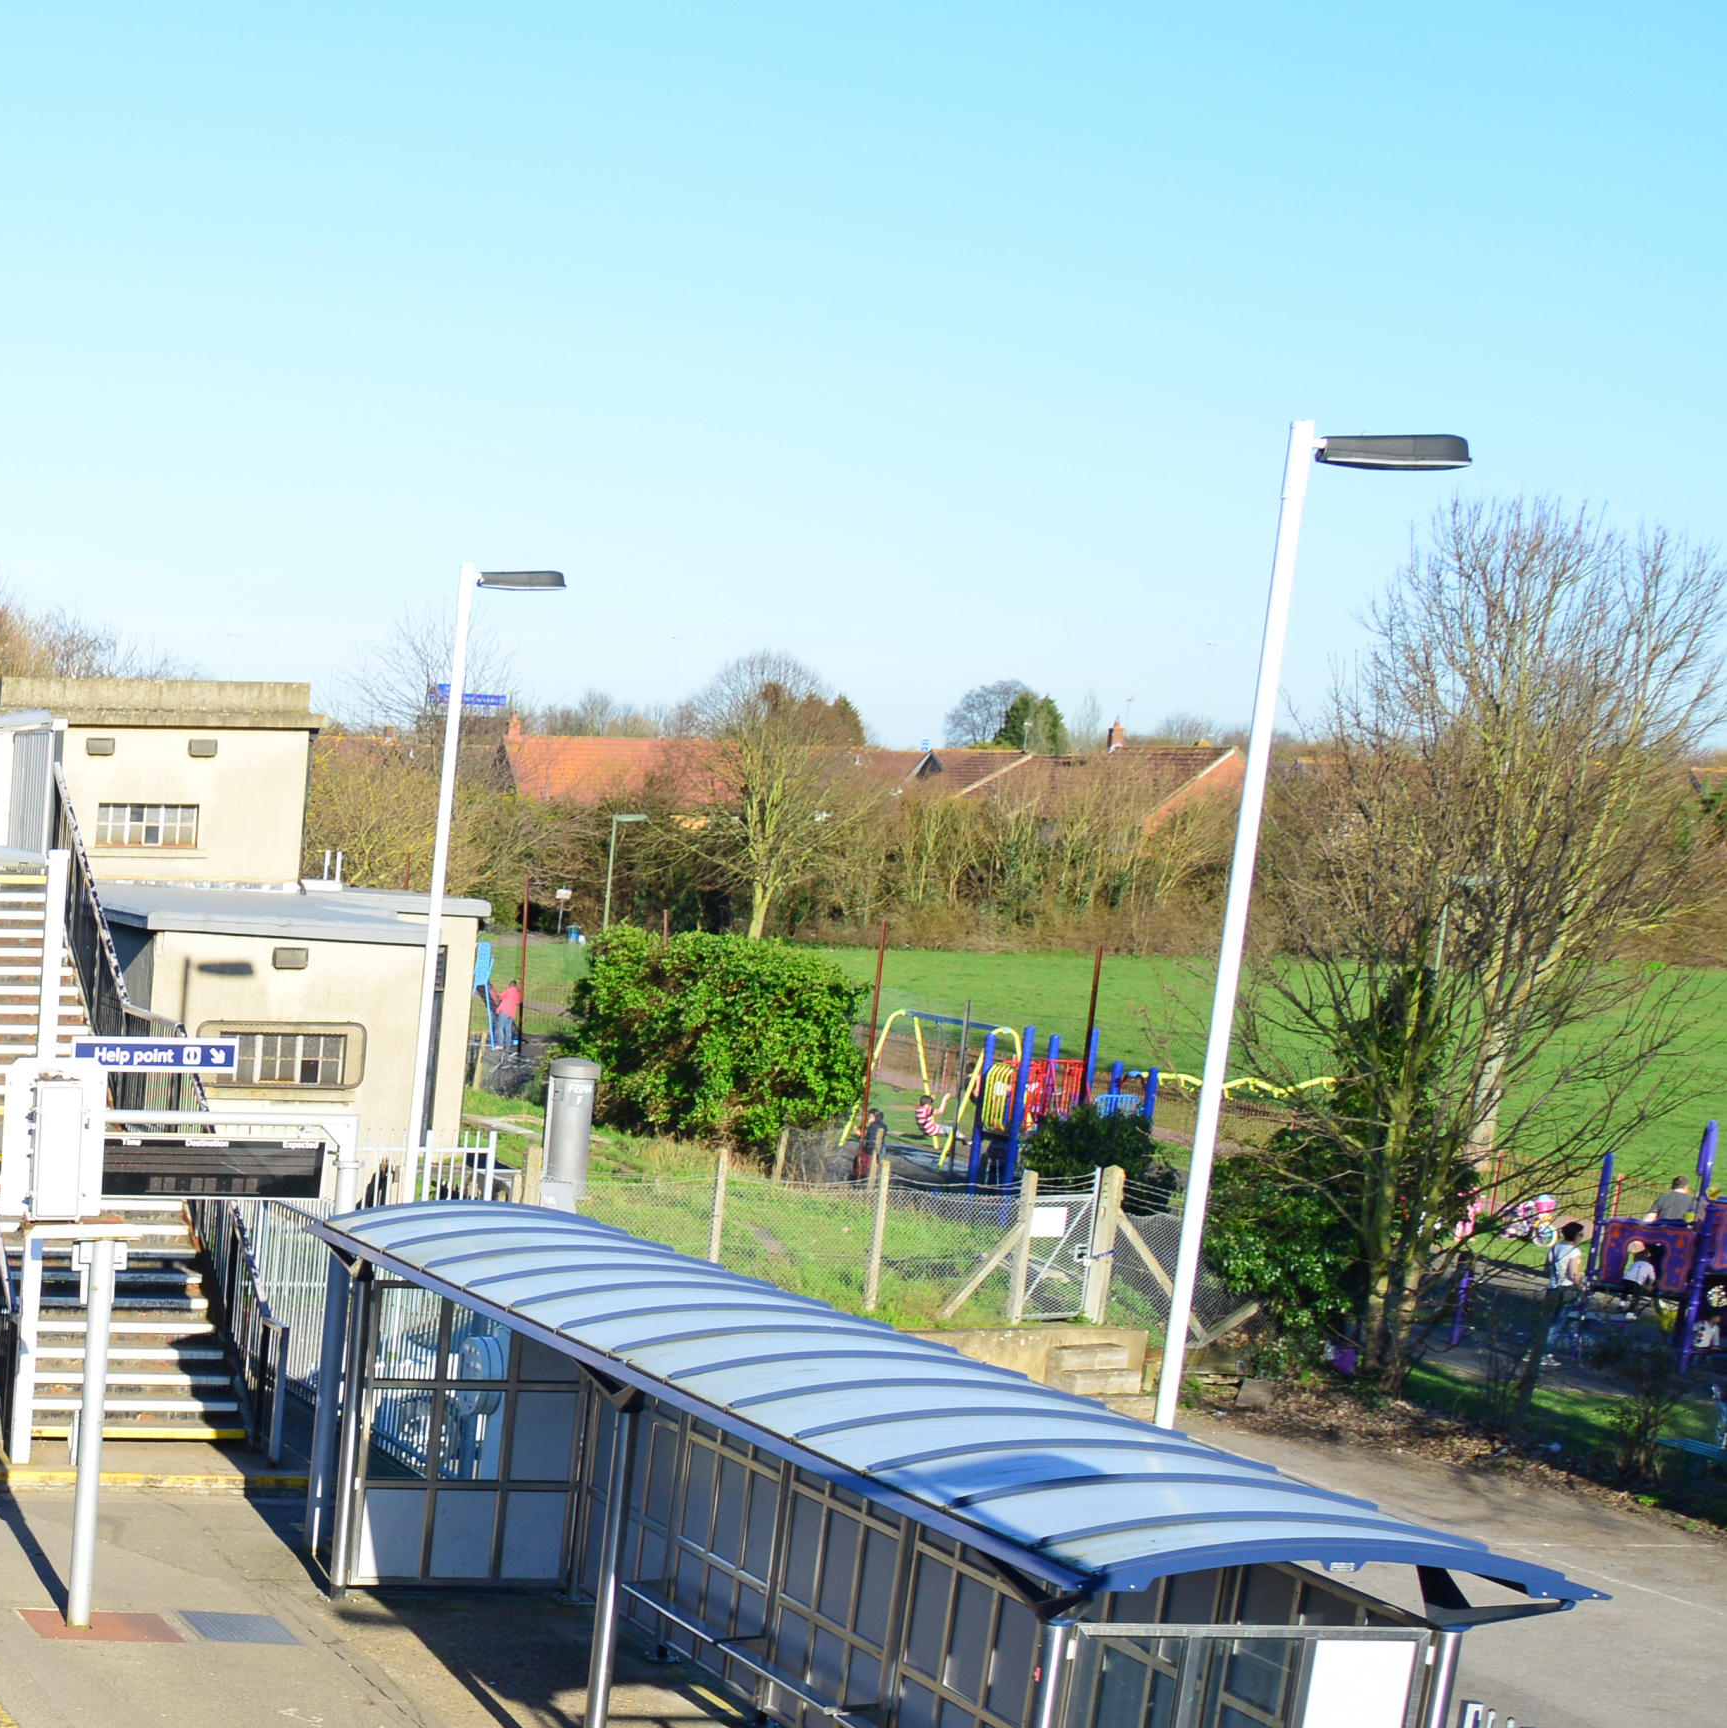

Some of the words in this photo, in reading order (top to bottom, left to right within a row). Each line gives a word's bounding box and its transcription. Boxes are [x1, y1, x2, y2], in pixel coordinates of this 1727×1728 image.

[94, 1046, 131, 1066] Help
[133, 1048, 175, 1066] point
[122, 1138, 142, 1147] Time
[185, 1139, 230, 1148] Destination
[282, 1141, 320, 1150] Expected
